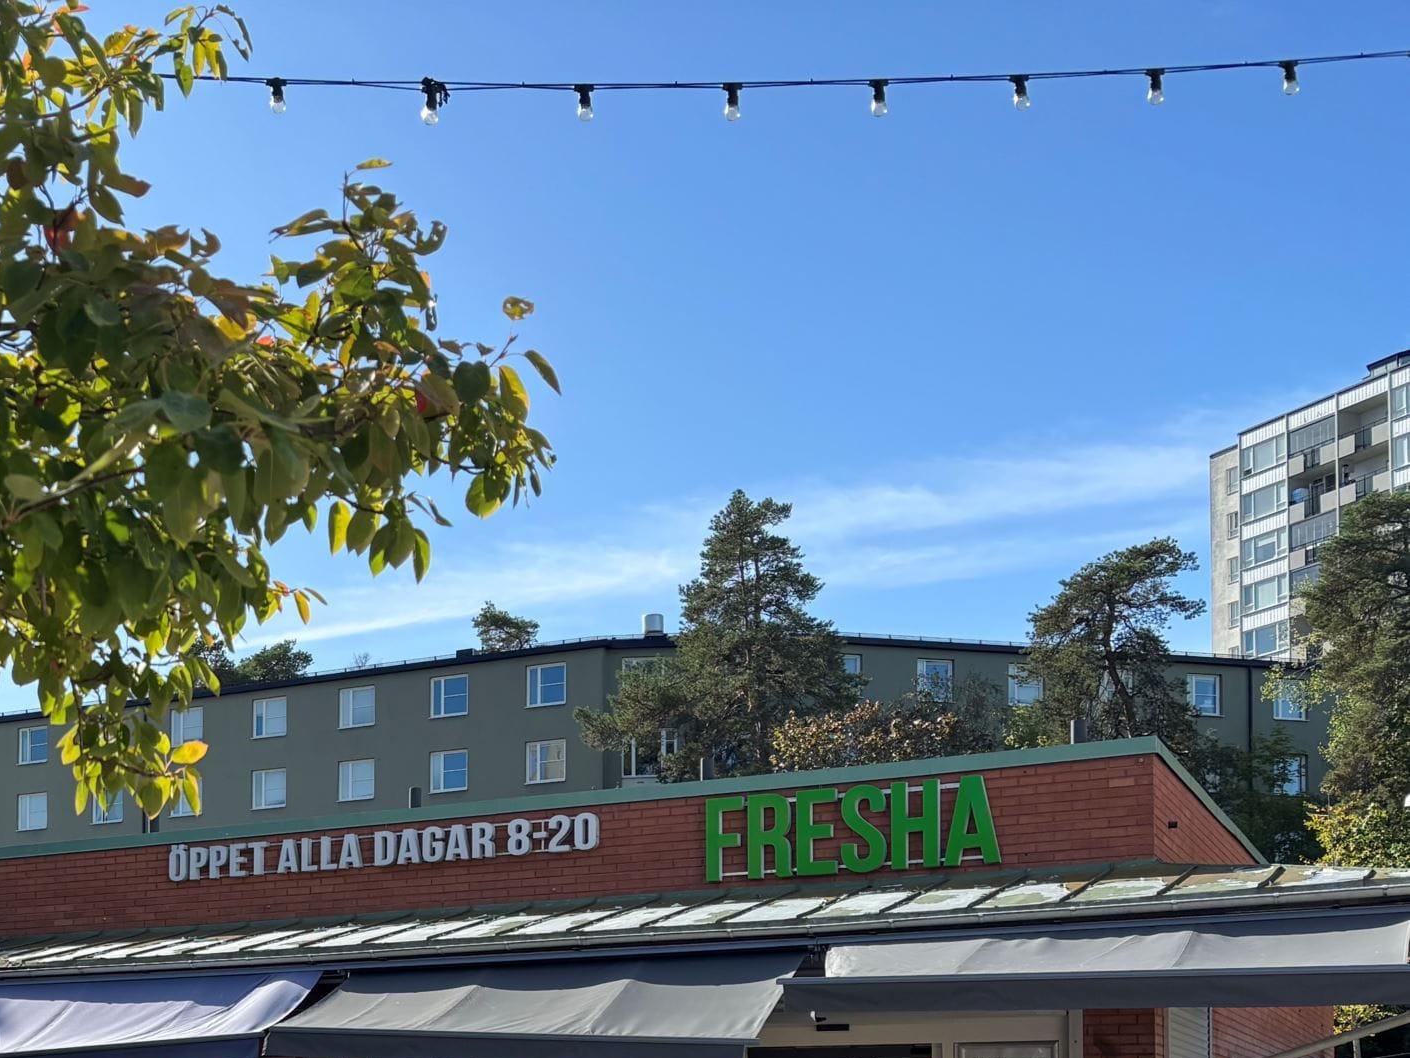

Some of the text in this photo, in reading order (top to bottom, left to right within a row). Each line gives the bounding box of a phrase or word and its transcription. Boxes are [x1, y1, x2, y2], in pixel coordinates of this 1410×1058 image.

[168, 811, 601, 882] ÖPPET ALLA DAGAR 8-20
[705, 774, 1002, 881] FRESHA
